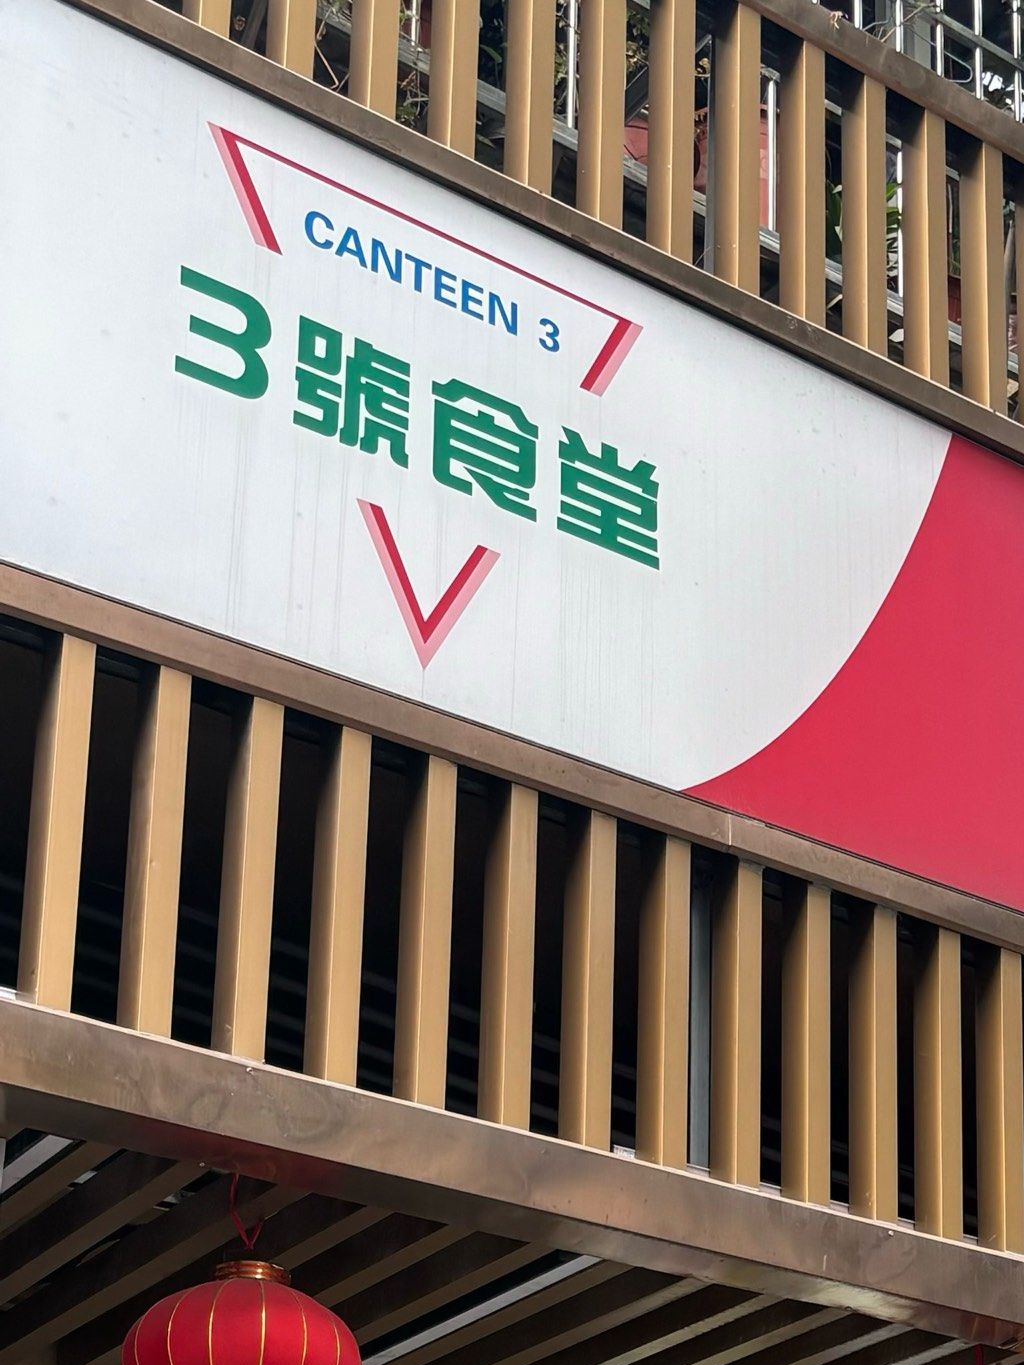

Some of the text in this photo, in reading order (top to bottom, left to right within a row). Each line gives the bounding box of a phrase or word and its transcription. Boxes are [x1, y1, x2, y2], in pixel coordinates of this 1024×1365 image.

[303, 210, 561, 353] CANTEEN 3
[174, 264, 661, 570] 3號食堂
